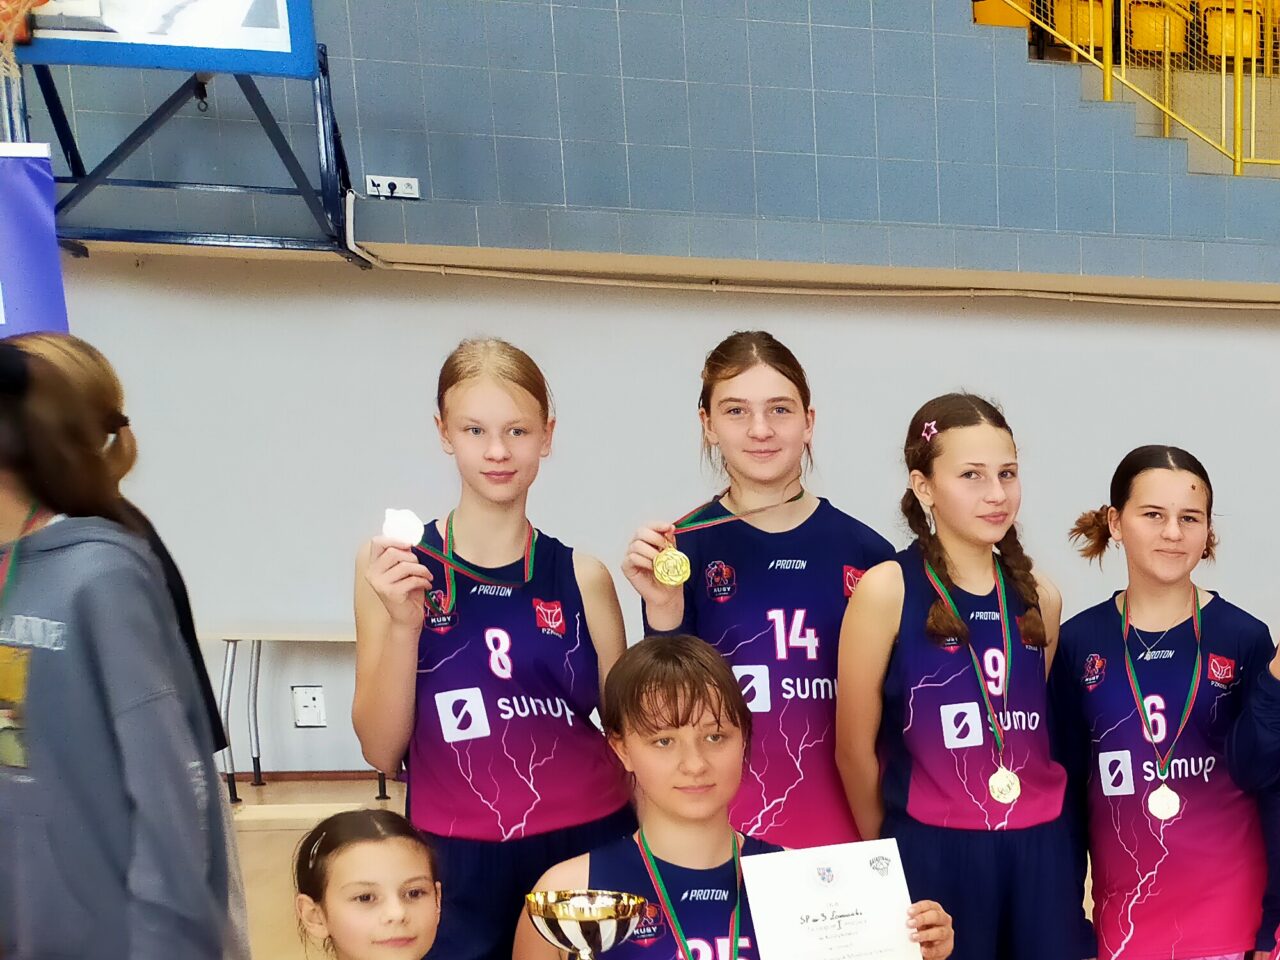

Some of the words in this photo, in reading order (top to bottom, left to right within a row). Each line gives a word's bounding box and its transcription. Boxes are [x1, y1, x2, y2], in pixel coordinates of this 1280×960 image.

[775, 559, 807, 570] PROTON
[478, 585, 512, 597] PROTON
[975, 611, 1000, 620] PROTON
[767, 609, 819, 660] 14
[485, 628, 512, 679] 8
[984, 648, 1005, 696] 9
[781, 677, 839, 700] sum
[1142, 695, 1167, 743] 6
[1143, 756, 1216, 782] sumup
[689, 889, 729, 901] PROTON
